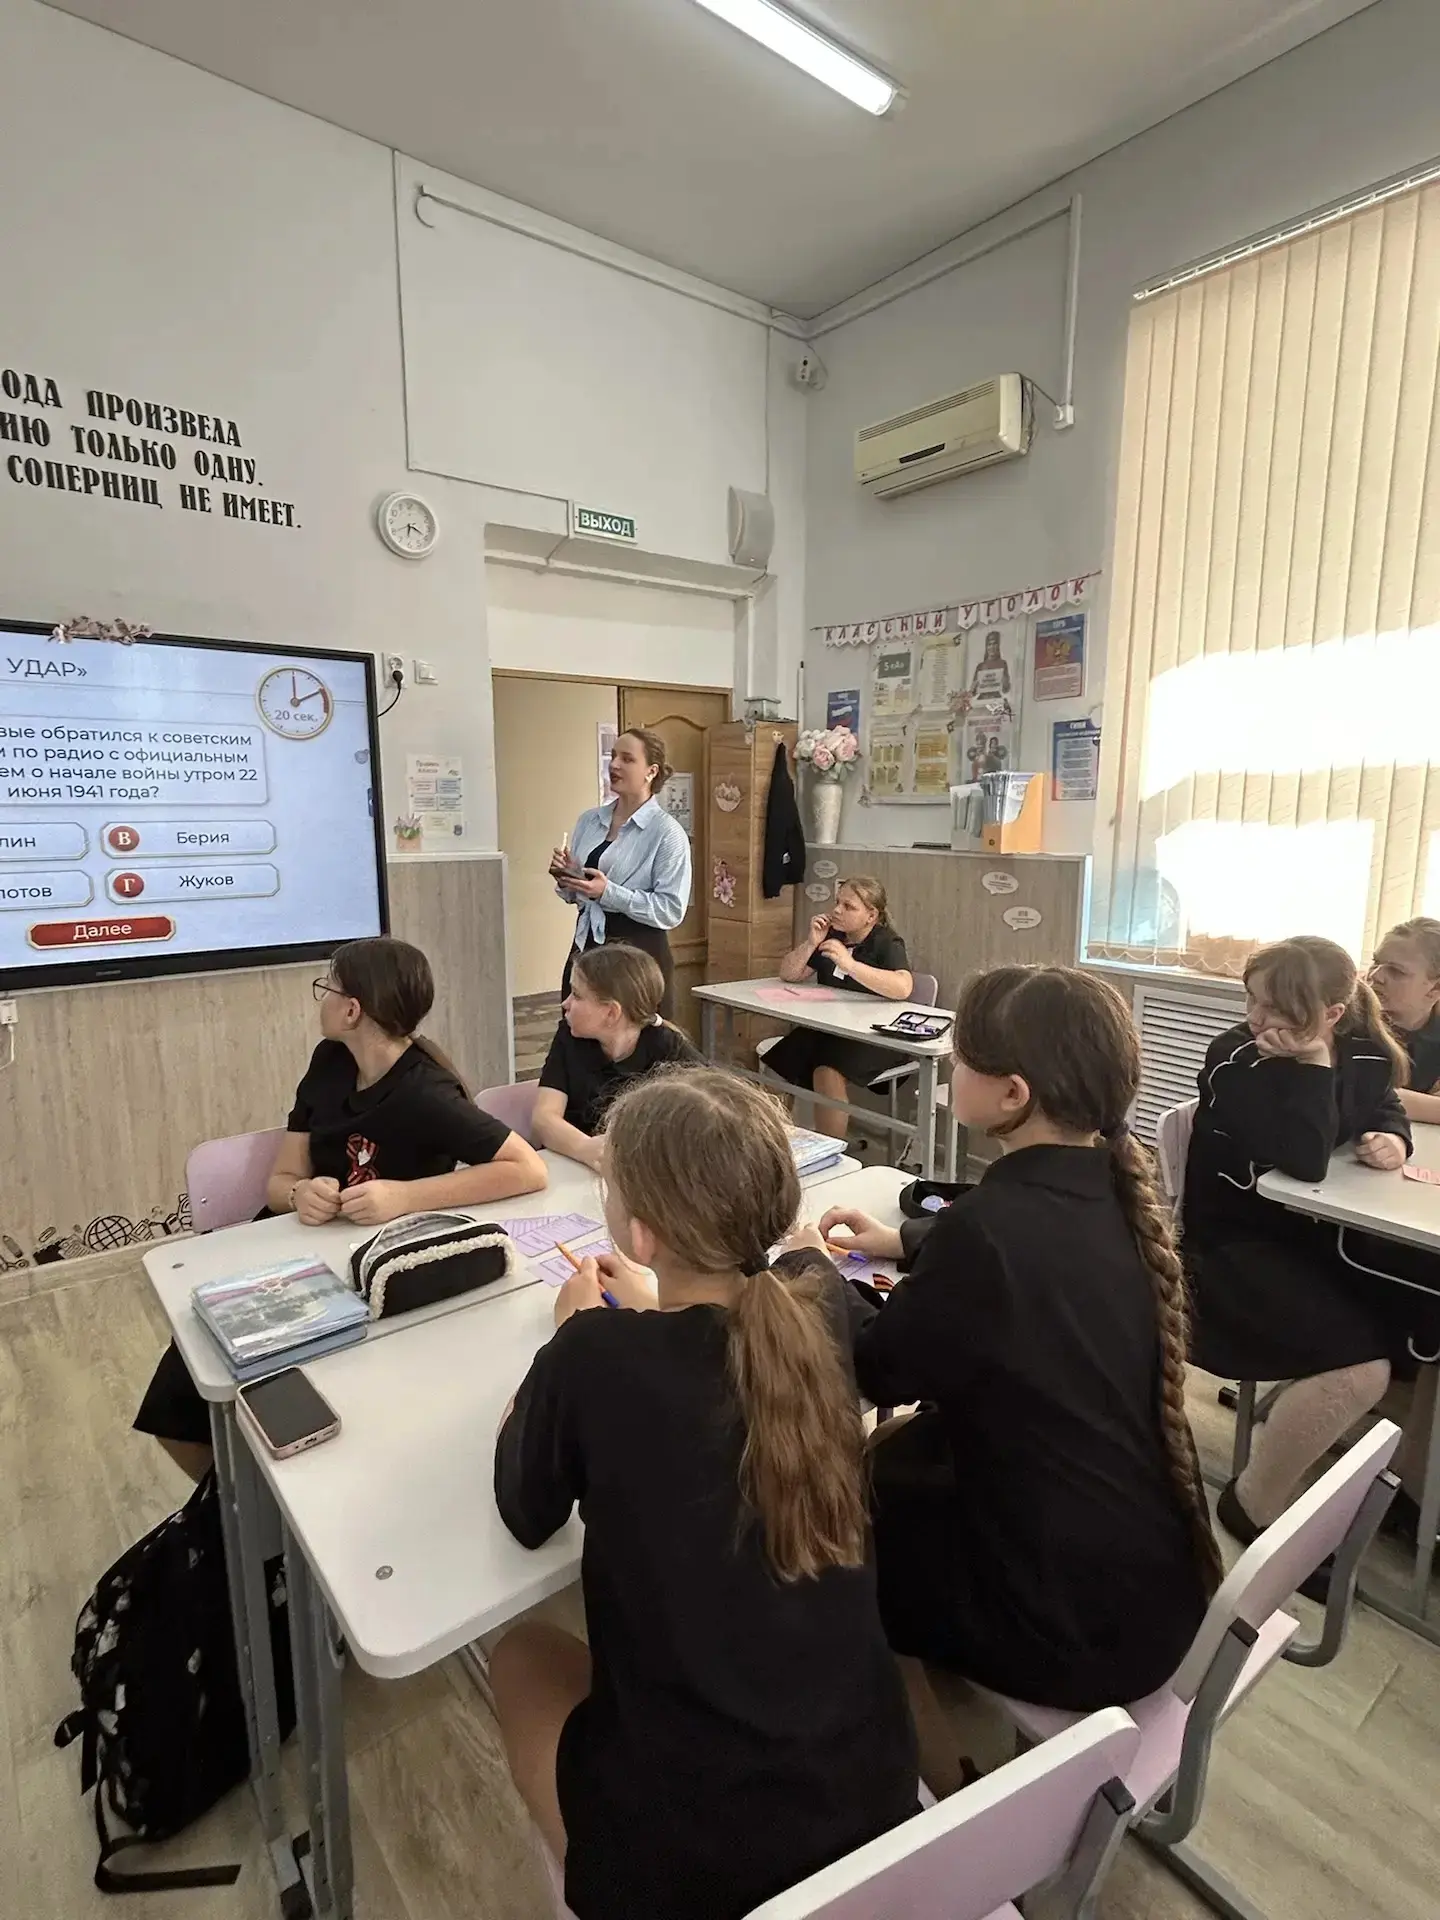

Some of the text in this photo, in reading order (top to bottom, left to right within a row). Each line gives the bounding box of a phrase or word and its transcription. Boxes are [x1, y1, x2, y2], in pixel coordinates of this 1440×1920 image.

[1, 369, 242, 448] ОДА ПРОИЗВЕЛА
[0, 411, 264, 487] ИЮ ТОЛЬКО ОДНУ.
[7, 454, 302, 529] СОПЕРНИЦ НЕ ИМЕЕТ.
[580, 511, 632, 537] ВЫХОД
[963, 579, 1084, 621] УГОЛОК
[6, 657, 88, 678] УДАР»
[274, 709, 318, 722] 20 сек.
[41, 725, 143, 743] обратился
[148, 732, 159, 744] к
[162, 732, 252, 745] советским
[13, 747, 38, 759] по
[44, 748, 104, 762] радио
[109, 750, 120, 760] с
[124, 747, 248, 764] официальным
[31, 768, 43, 778] о
[49, 768, 117, 779] начале
[122, 767, 180, 780] войны
[184, 770, 236, 783] утром
[238, 769, 258, 781] 22
[8, 784, 159, 800] июня 1941 года?
[117, 831, 230, 846] В Берия
[123, 874, 235, 893] Г Жуков
[73, 923, 133, 941] Далее
